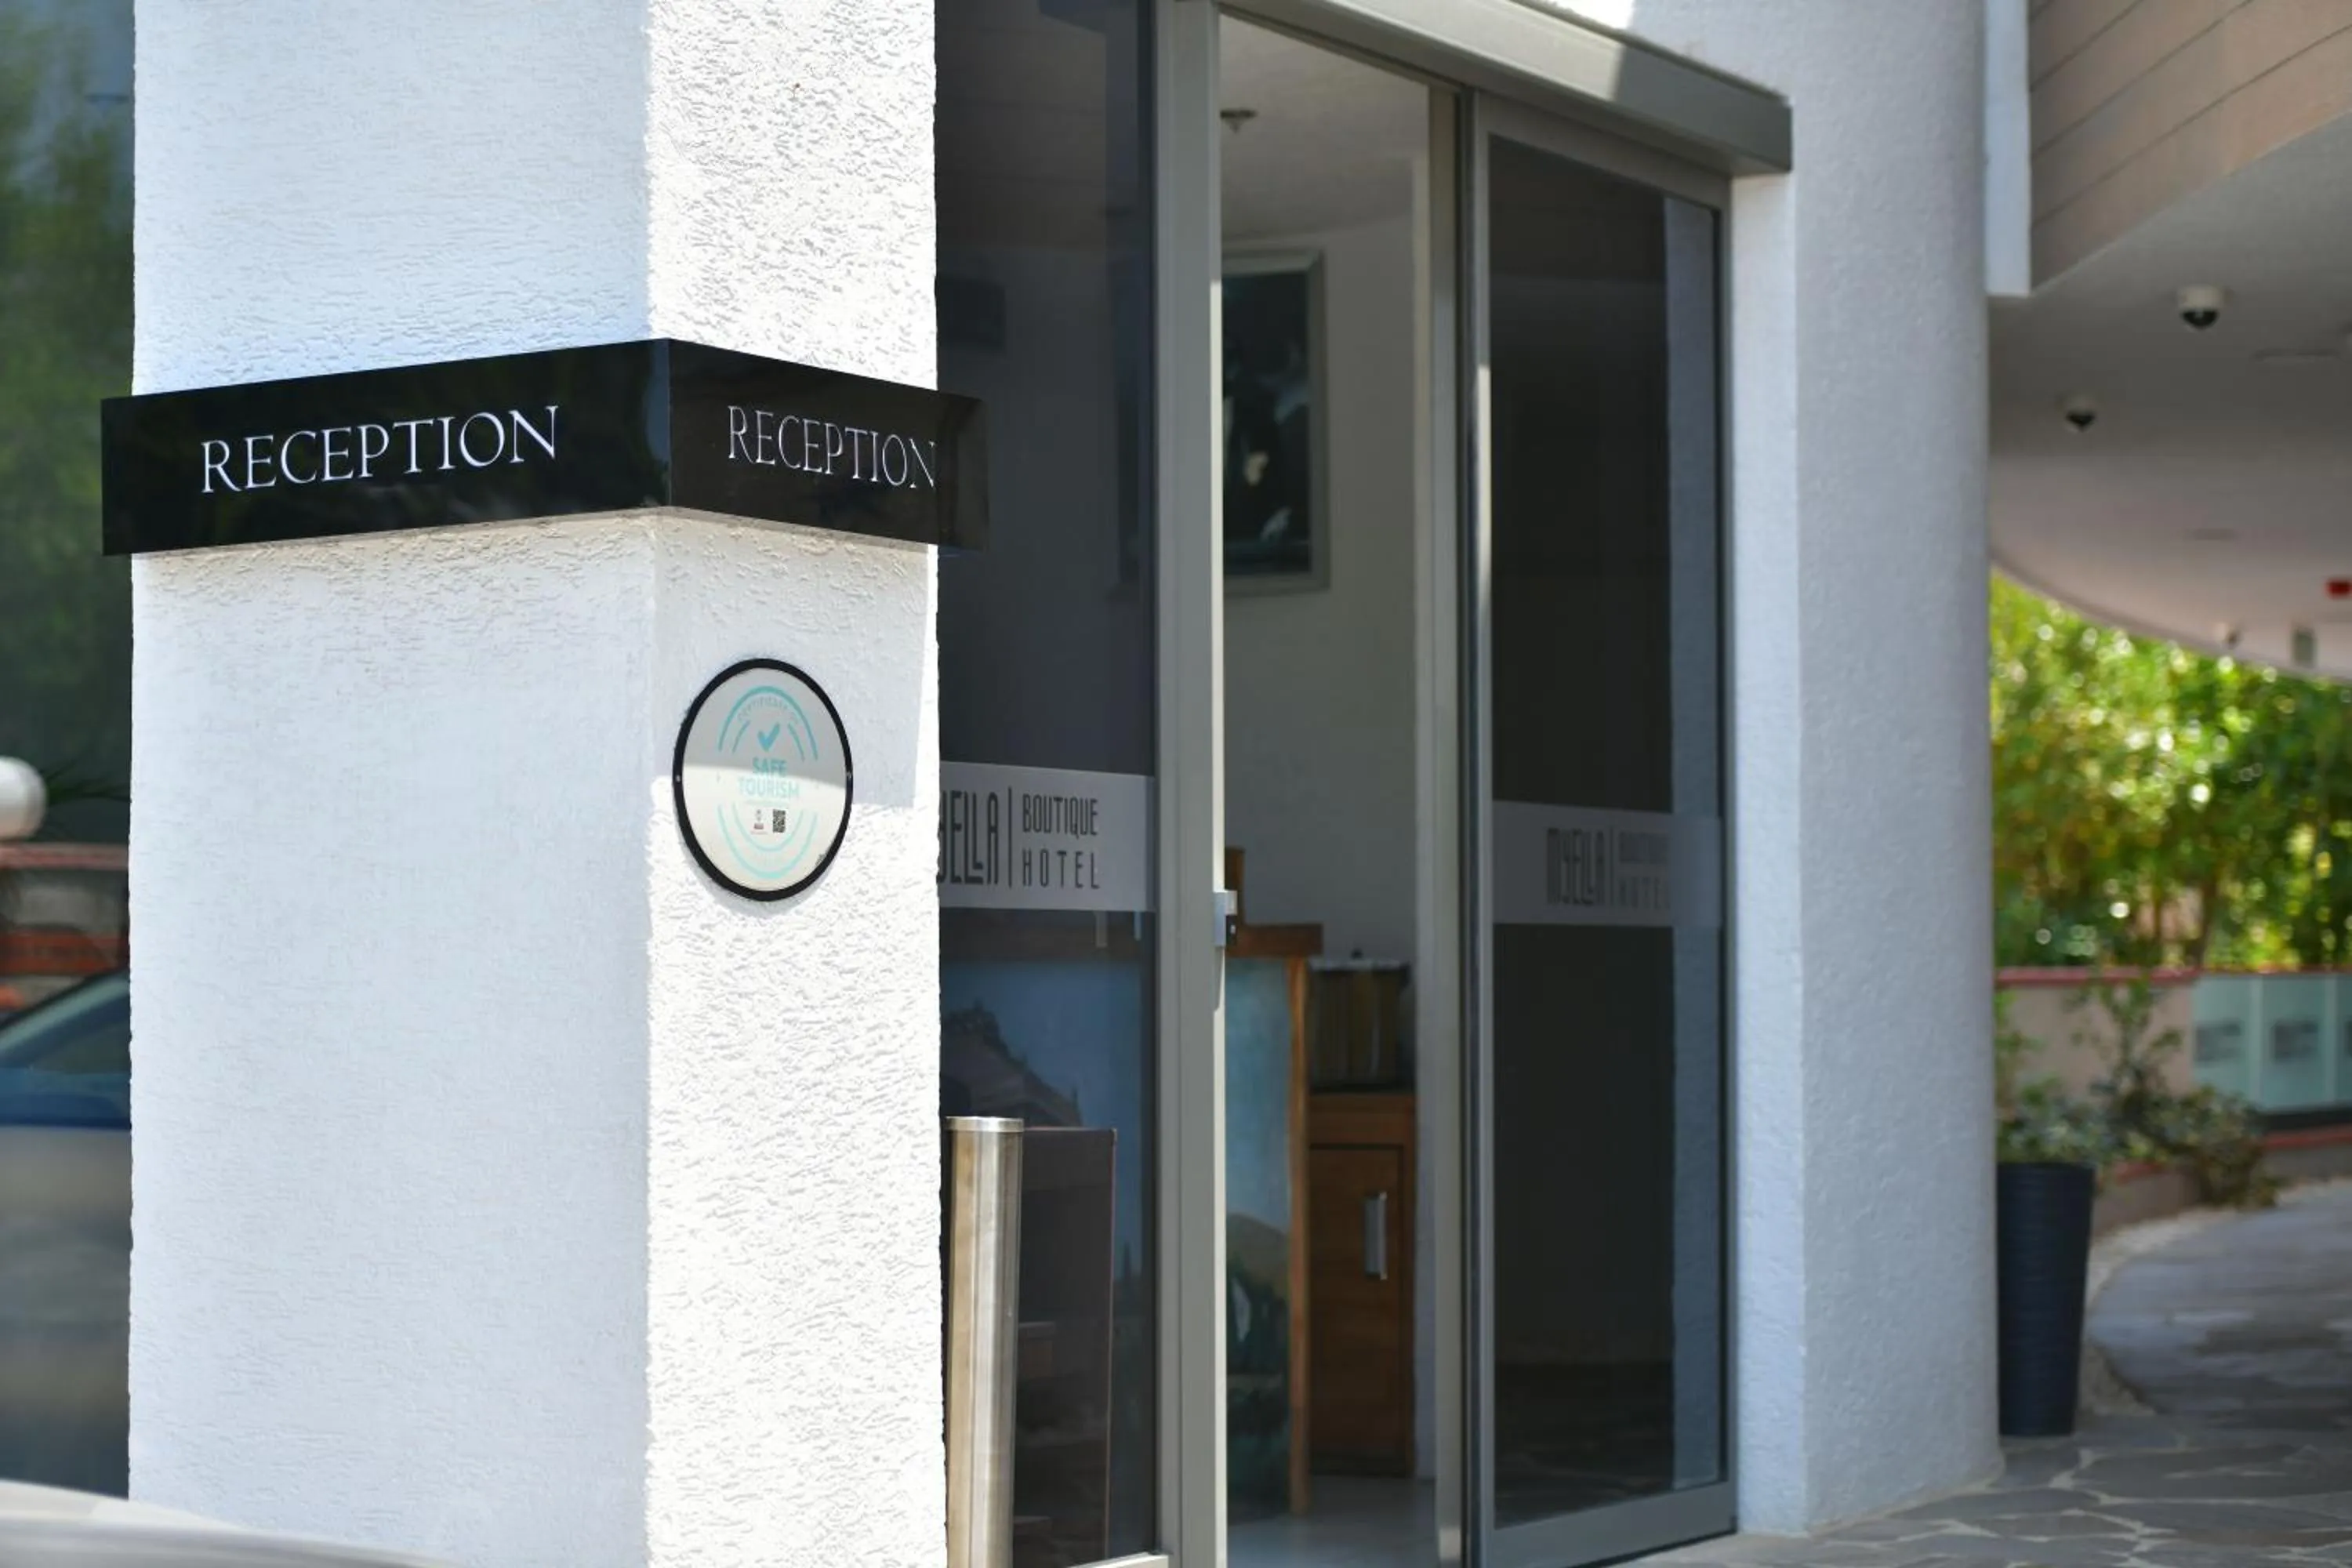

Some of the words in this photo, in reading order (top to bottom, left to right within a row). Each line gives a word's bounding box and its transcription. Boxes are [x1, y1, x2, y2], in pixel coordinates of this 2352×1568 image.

[201, 405, 558, 492] RECEPTION
[728, 405, 937, 489] RECEPTION
[738, 777, 800, 799] TOURISM
[752, 756, 787, 777] SAFE
[1022, 793, 1099, 839] BOUTIQUE
[1022, 848, 1101, 889] HOTEL
